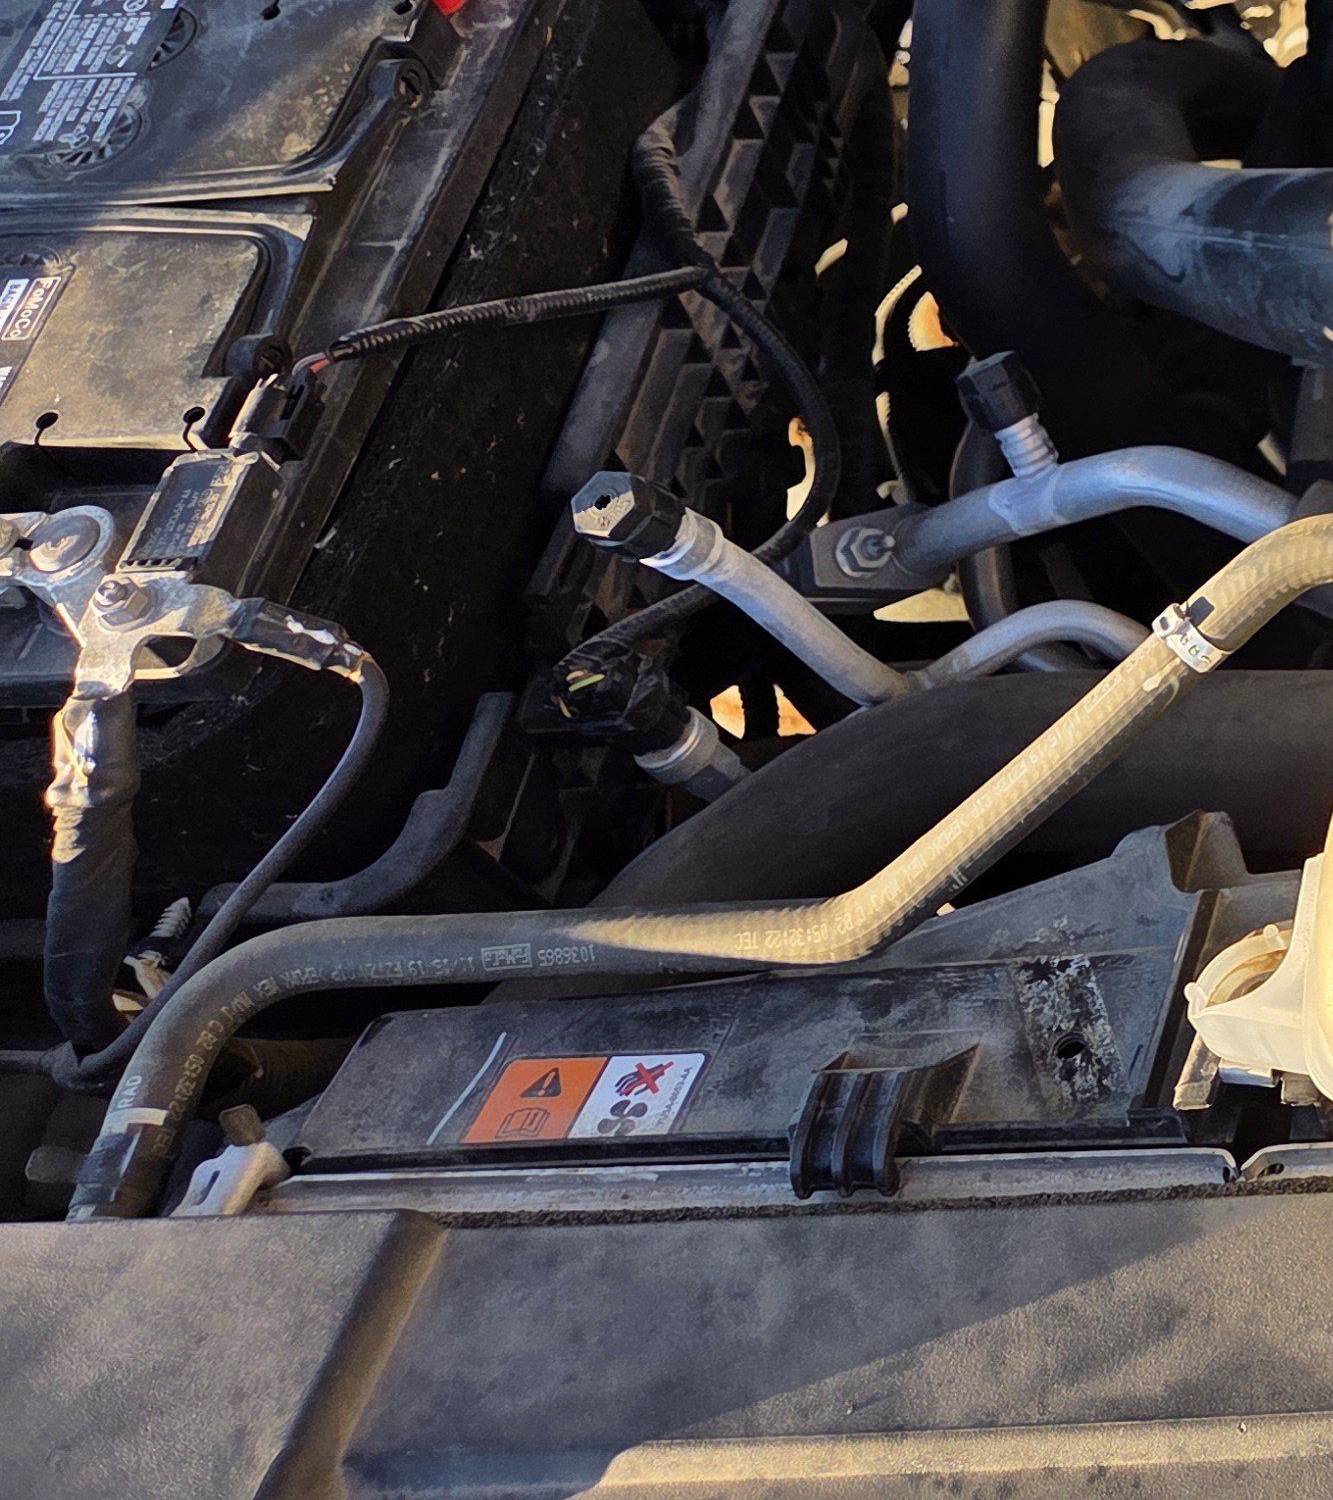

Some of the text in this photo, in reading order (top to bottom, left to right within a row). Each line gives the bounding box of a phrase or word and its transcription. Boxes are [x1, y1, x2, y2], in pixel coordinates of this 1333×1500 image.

[10, 277, 50, 338] FoMoCo
[734, 931, 758, 949] TEC
[536, 943, 595, 966] 1036865
[118, 1075, 142, 1109] RAD
